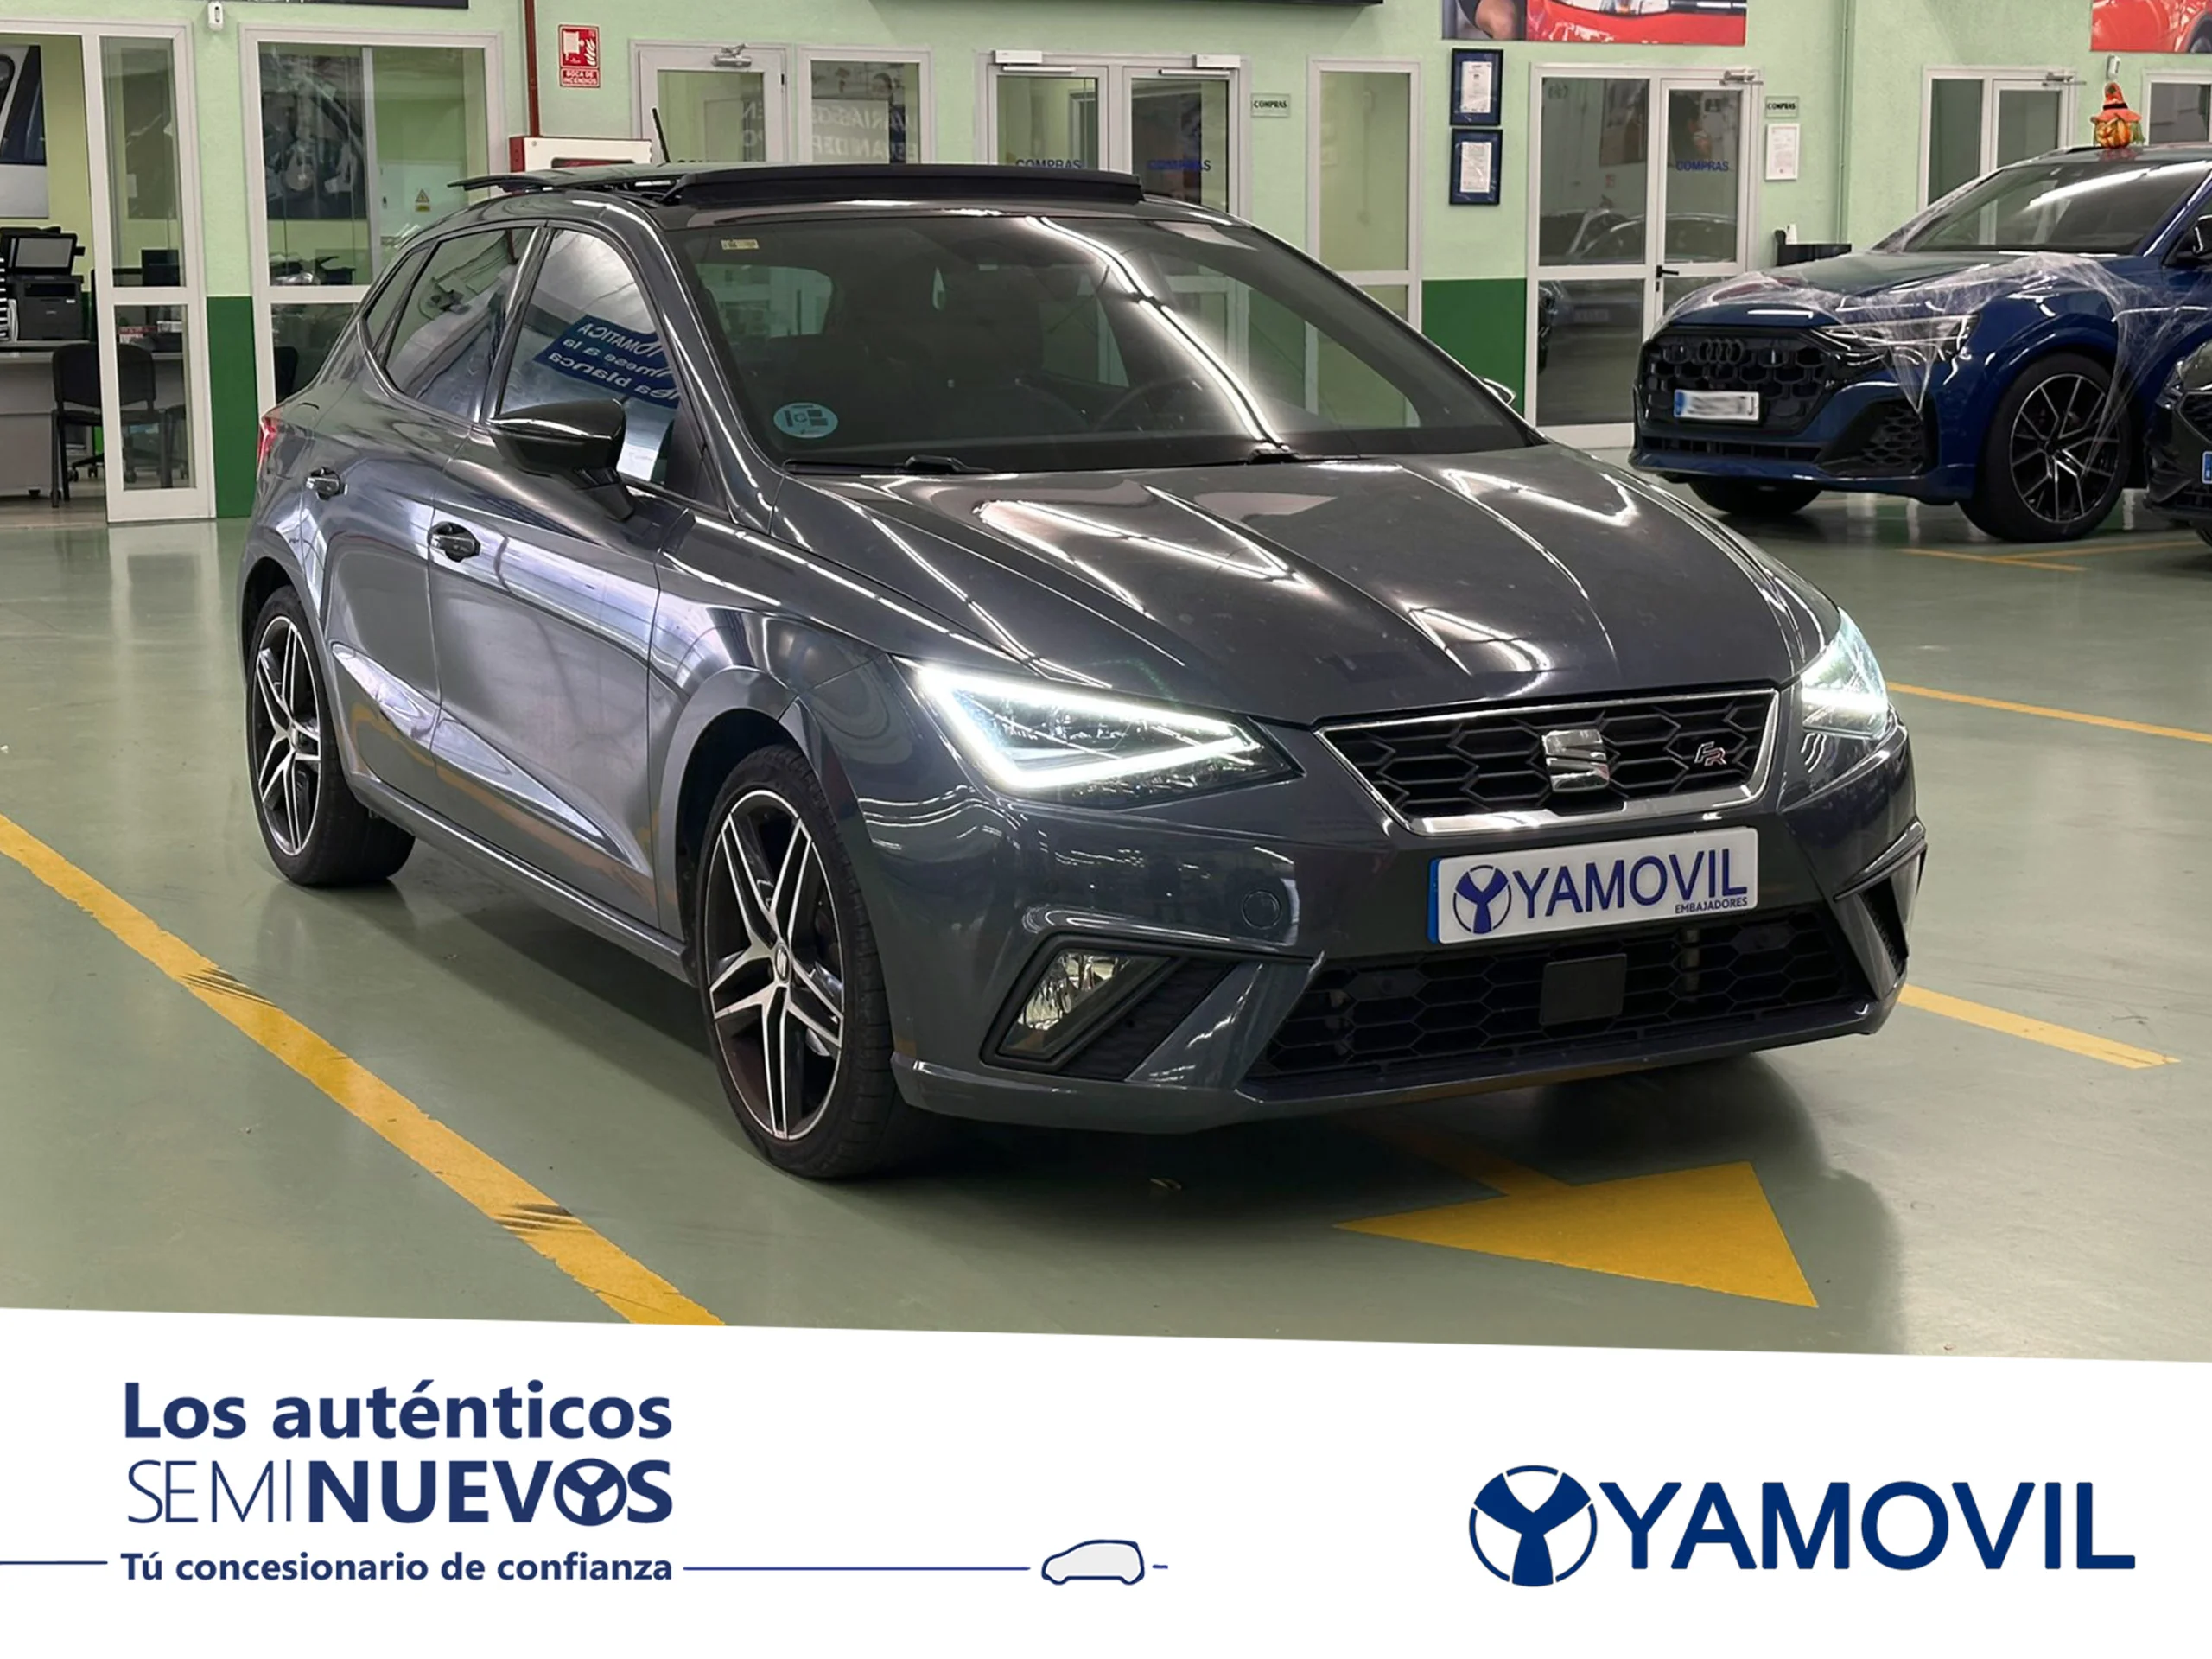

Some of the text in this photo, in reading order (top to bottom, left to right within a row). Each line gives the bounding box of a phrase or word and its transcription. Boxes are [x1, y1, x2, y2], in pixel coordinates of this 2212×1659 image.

[1675, 161, 1729, 172] COMPRAS
[1512, 848, 1748, 918] YAMOVIL
[1675, 897, 1748, 915] EMBAJADORES
